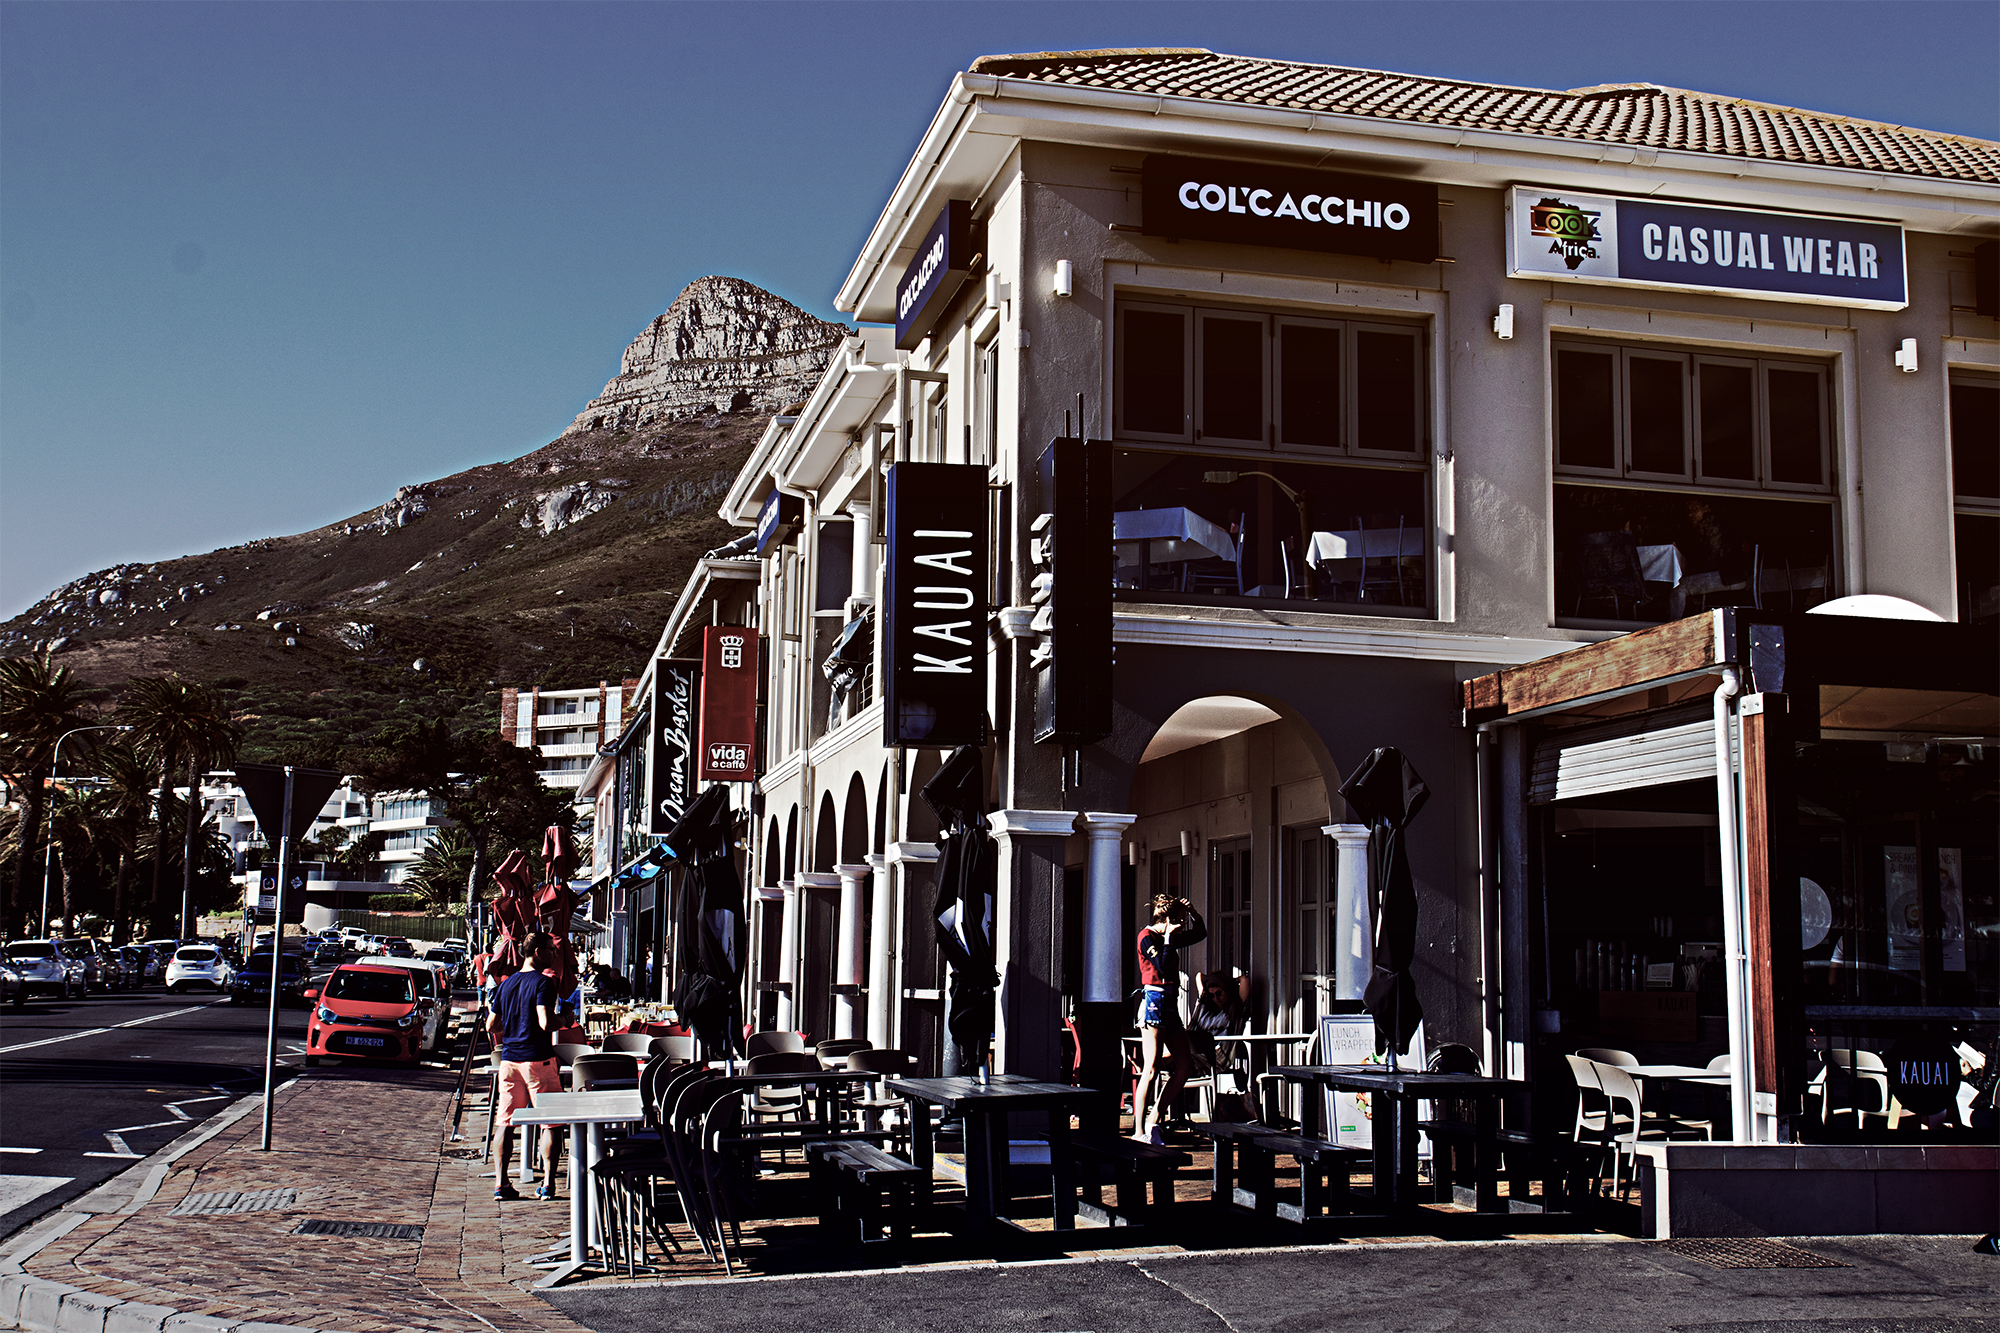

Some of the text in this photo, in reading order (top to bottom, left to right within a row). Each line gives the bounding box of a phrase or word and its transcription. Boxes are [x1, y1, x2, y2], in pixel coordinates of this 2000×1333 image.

[1530, 211, 1601, 236] LOOK
[1642, 222, 1879, 279] CASUAL WEAR
[913, 530, 974, 673] KAUAI
[711, 745, 746, 760] vida
[711, 760, 719, 768] e
[1657, 997, 1689, 1011] KAUAI
[1900, 1061, 1949, 1085] KAUAI
